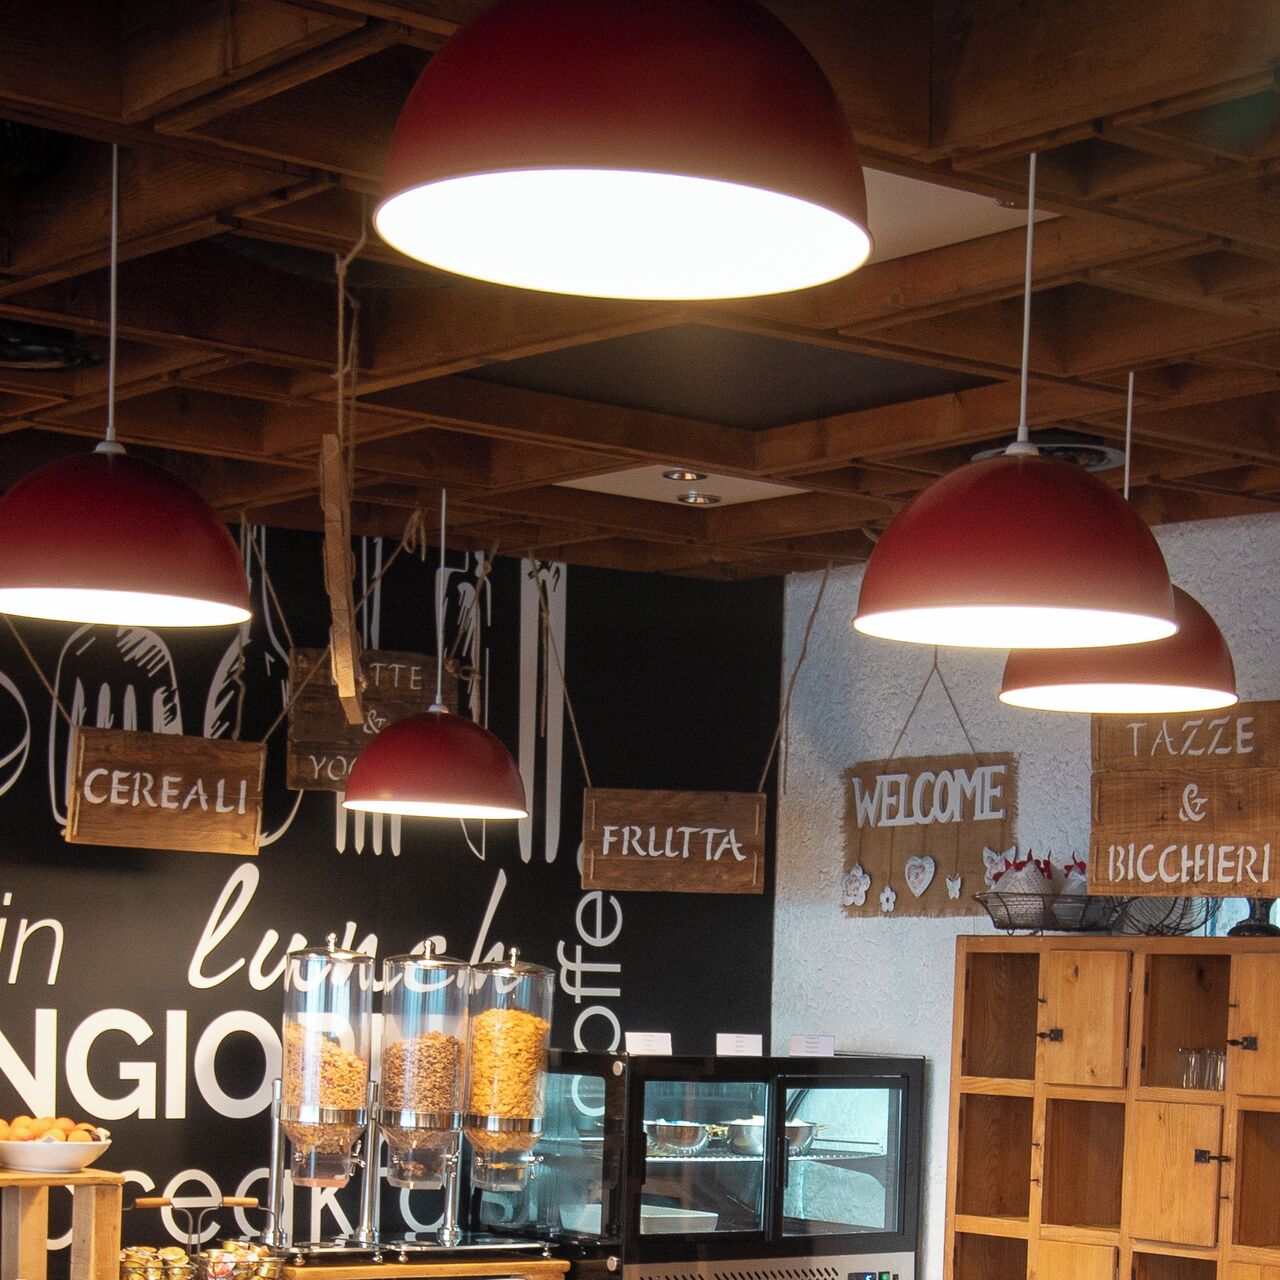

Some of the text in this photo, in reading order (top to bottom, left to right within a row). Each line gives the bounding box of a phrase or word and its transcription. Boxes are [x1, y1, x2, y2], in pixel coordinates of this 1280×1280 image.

[1126, 716, 1255, 757] TAZZE
[83, 767, 248, 815] CEREALI
[852, 765, 1007, 828] WELCOME
[1178, 783, 1209, 822] &
[601, 825, 747, 862] FRUTTA
[1108, 843, 1272, 885] BICCHIERI
